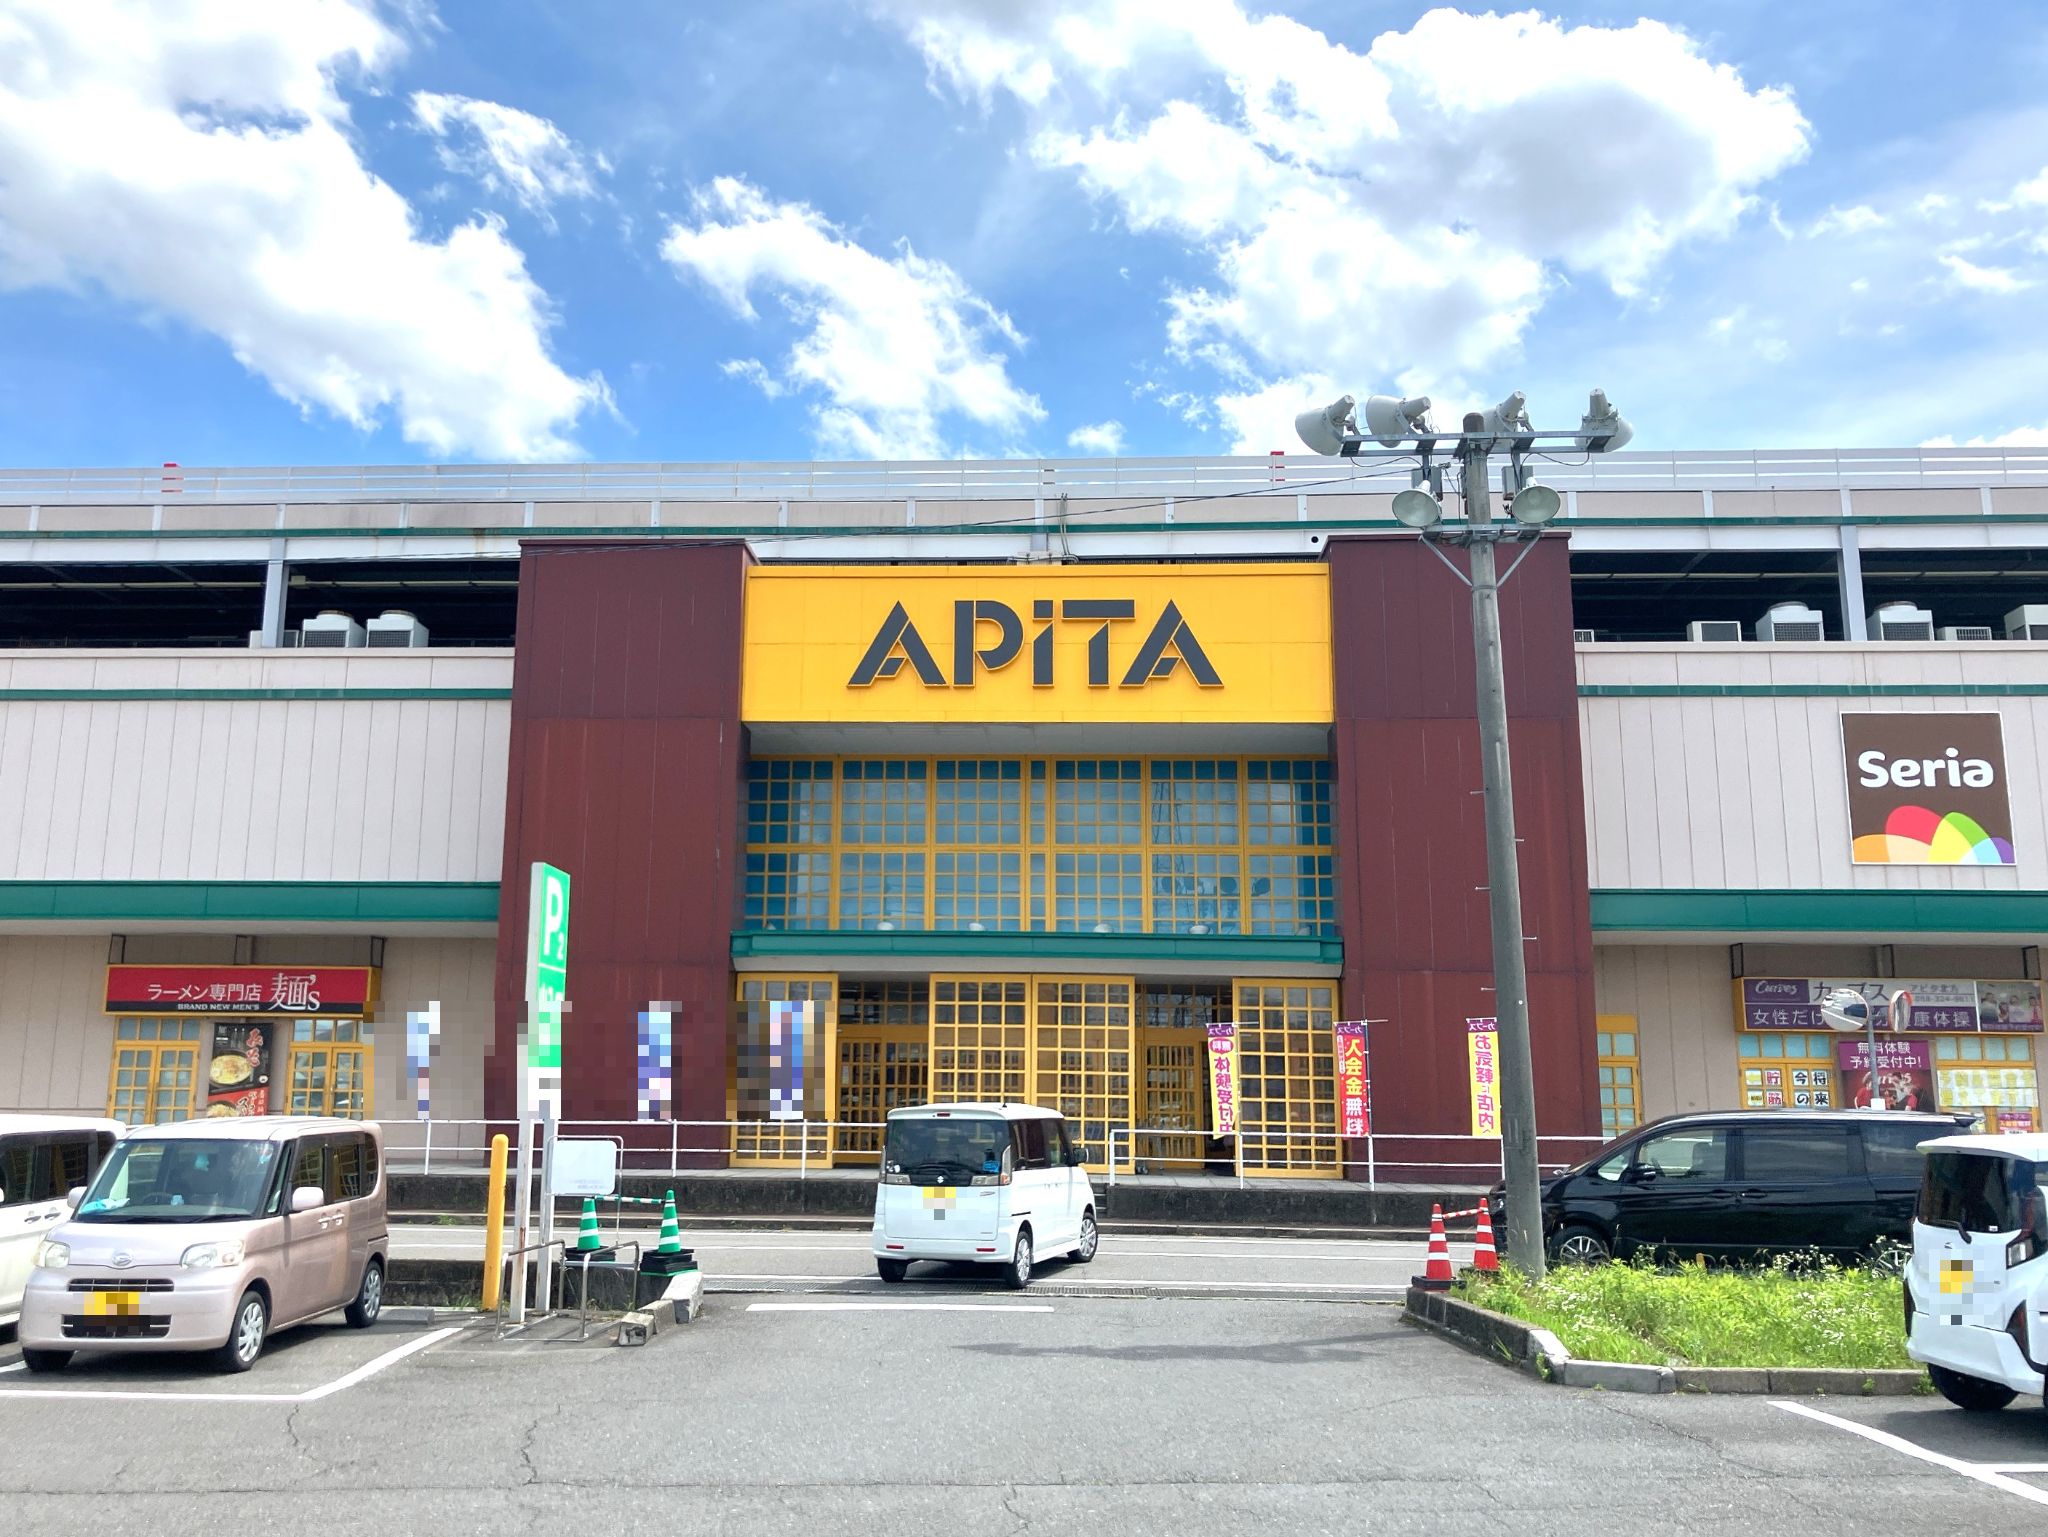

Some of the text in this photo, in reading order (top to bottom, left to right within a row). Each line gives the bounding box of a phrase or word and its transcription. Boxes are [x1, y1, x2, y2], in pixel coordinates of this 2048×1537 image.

[1858, 747, 1994, 788] Seria
[147, 983, 263, 1002] ラーメン専門店
[1755, 980, 1798, 996] Curves
[177, 1003, 208, 1011] BRAND
[210, 1003, 230, 1011] NEW
